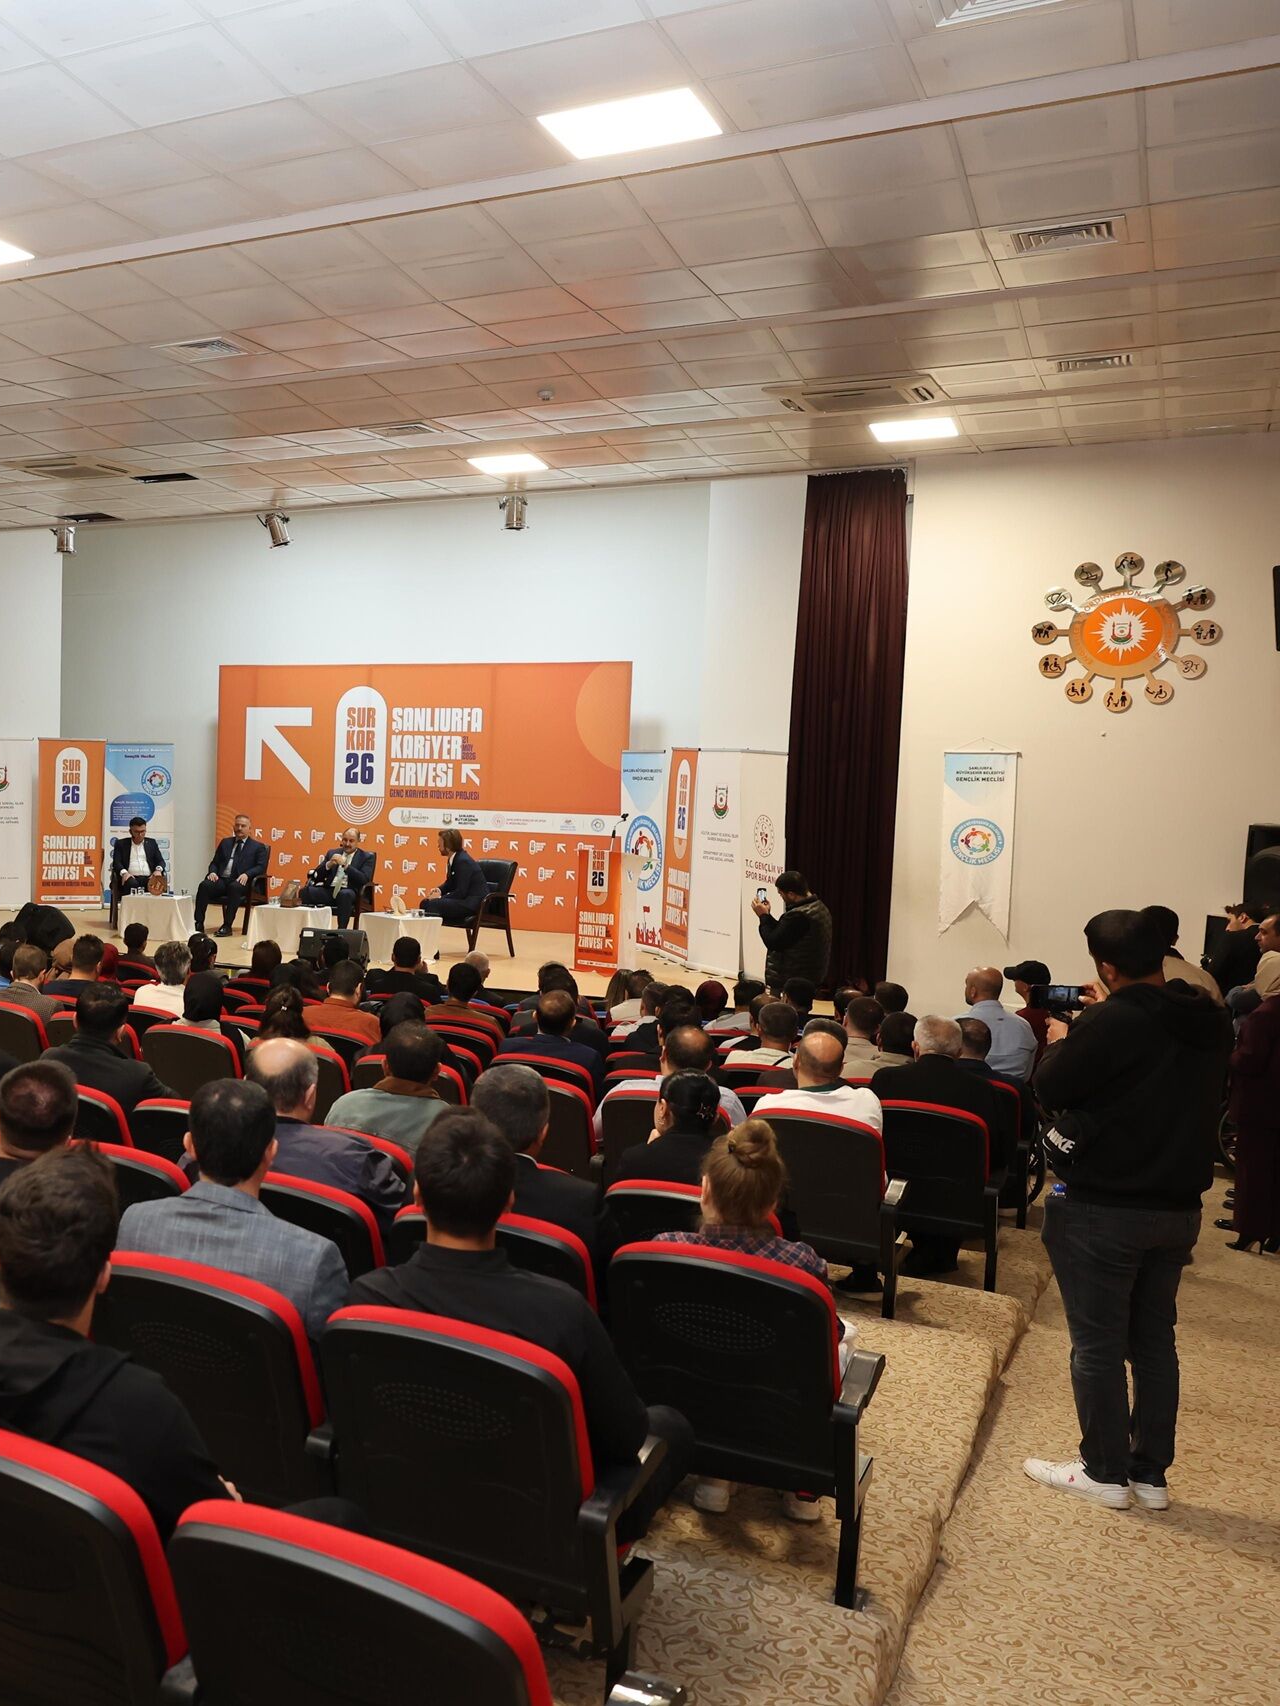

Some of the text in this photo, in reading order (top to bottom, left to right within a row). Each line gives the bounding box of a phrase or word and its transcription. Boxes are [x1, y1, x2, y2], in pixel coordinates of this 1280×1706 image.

[391, 707, 483, 733] ŞANLIURFA
[346, 730, 376, 751] KAR
[62, 772, 81, 784] KAR
[344, 752, 375, 785] 26
[389, 762, 454, 788] ZİRVESİ
[61, 785, 80, 804] 26
[591, 871, 605, 887] 26
[745, 870, 777, 885] SPOR BAKAN
[1046, 1126, 1076, 1154] NIKE
